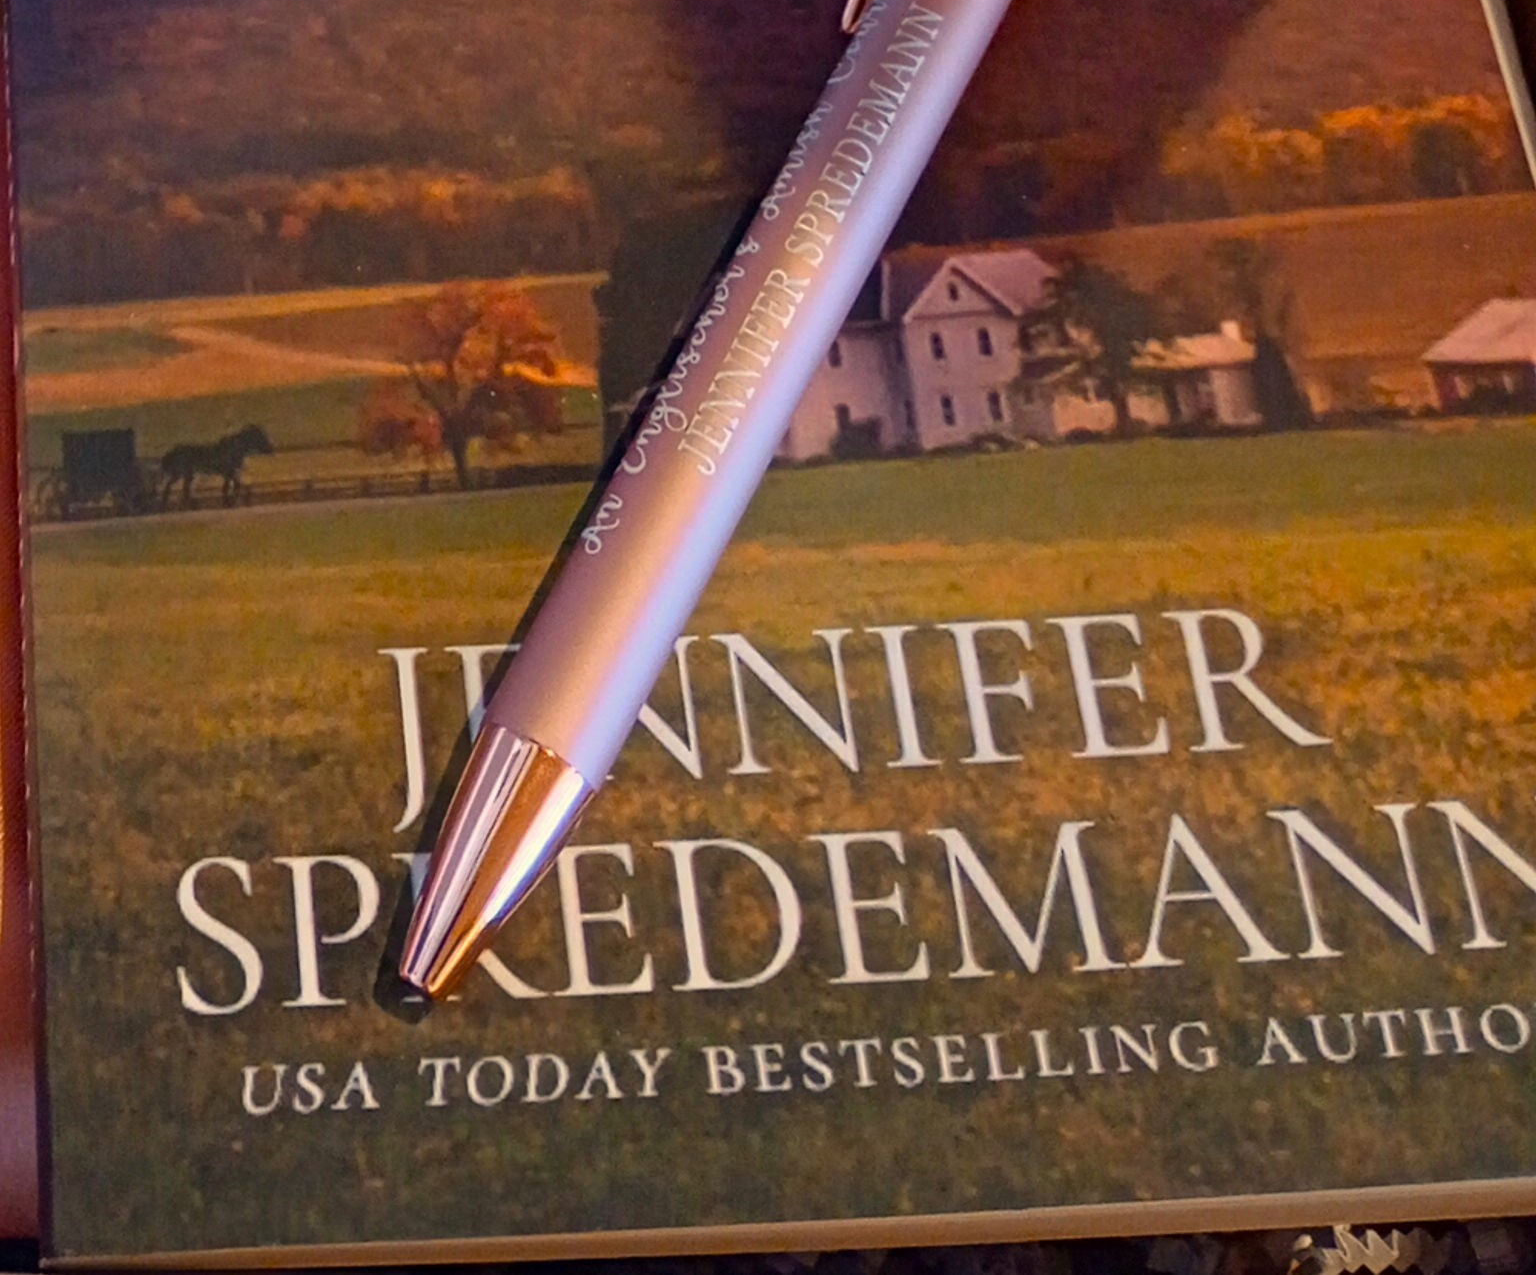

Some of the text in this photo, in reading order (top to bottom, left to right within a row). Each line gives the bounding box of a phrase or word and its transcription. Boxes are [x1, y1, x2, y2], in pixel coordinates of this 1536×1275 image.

[677, 0, 946, 477] JENNIFER SPREDEMANN
[582, 492, 623, 556] An
[242, 1003, 1536, 1116] USA TODAY BESTSELLING AUTHO
